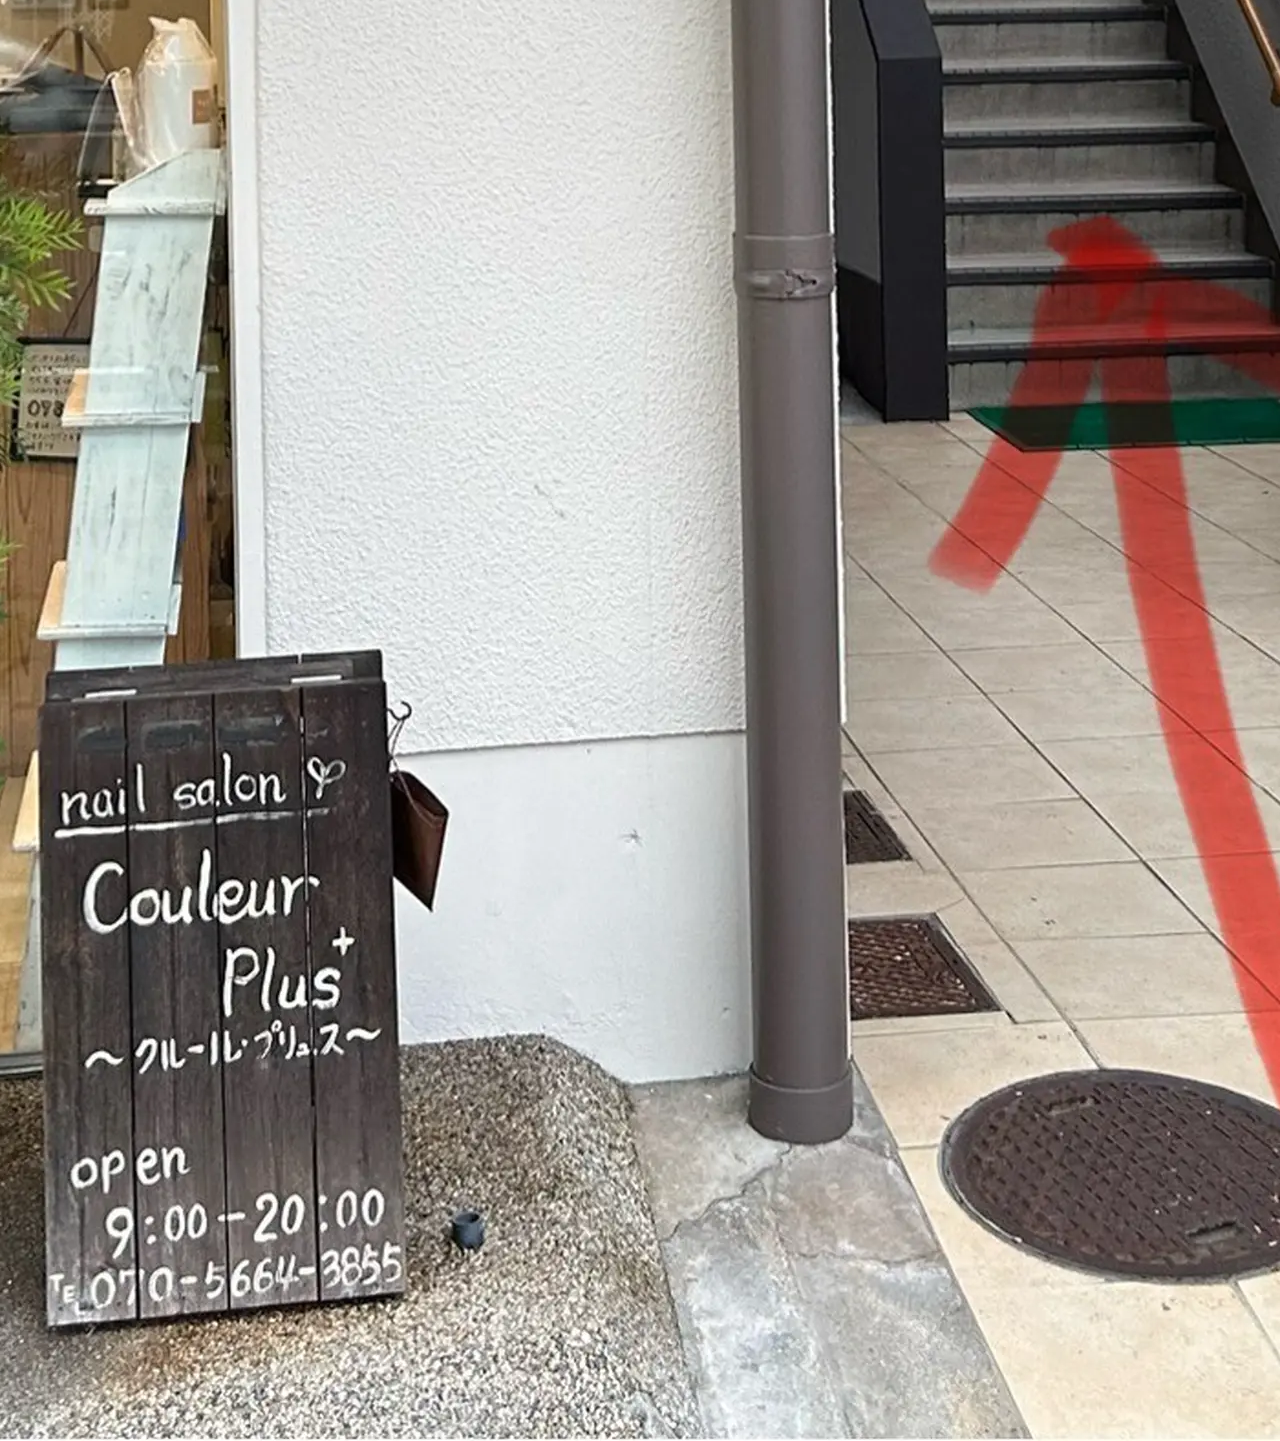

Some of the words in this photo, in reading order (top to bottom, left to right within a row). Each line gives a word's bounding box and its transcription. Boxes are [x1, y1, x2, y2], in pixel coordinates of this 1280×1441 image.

[60, 763, 147, 826] nail
[173, 752, 287, 811] salon
[82, 848, 321, 935] Couleur
[70, 1146, 191, 1193] open
